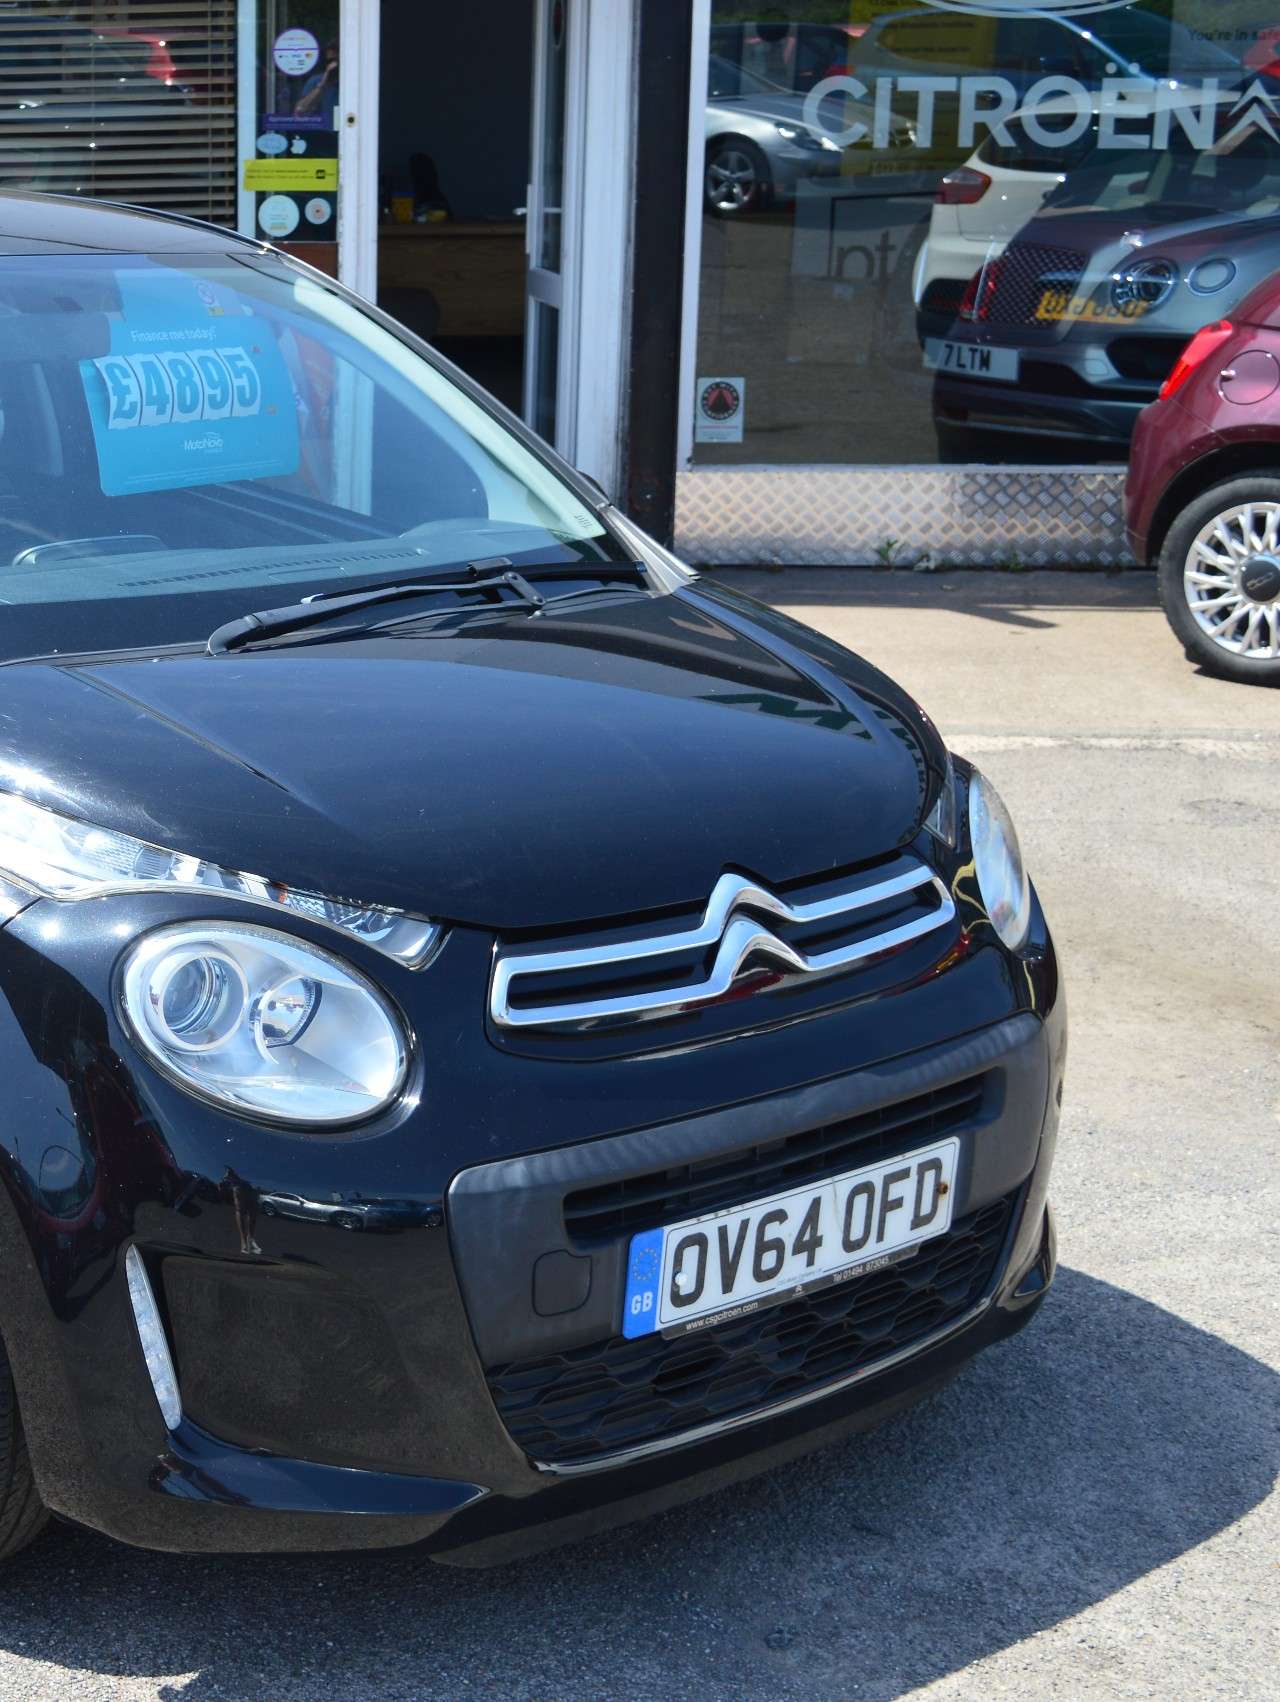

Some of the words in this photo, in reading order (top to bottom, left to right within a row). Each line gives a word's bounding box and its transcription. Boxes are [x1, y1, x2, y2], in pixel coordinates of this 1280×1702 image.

[803, 62, 1218, 150] CITROËN
[104, 353, 258, 419] £4895
[670, 1196, 823, 1309] OV64
[841, 1157, 944, 1254] OFD
[631, 1291, 654, 1315] GB
